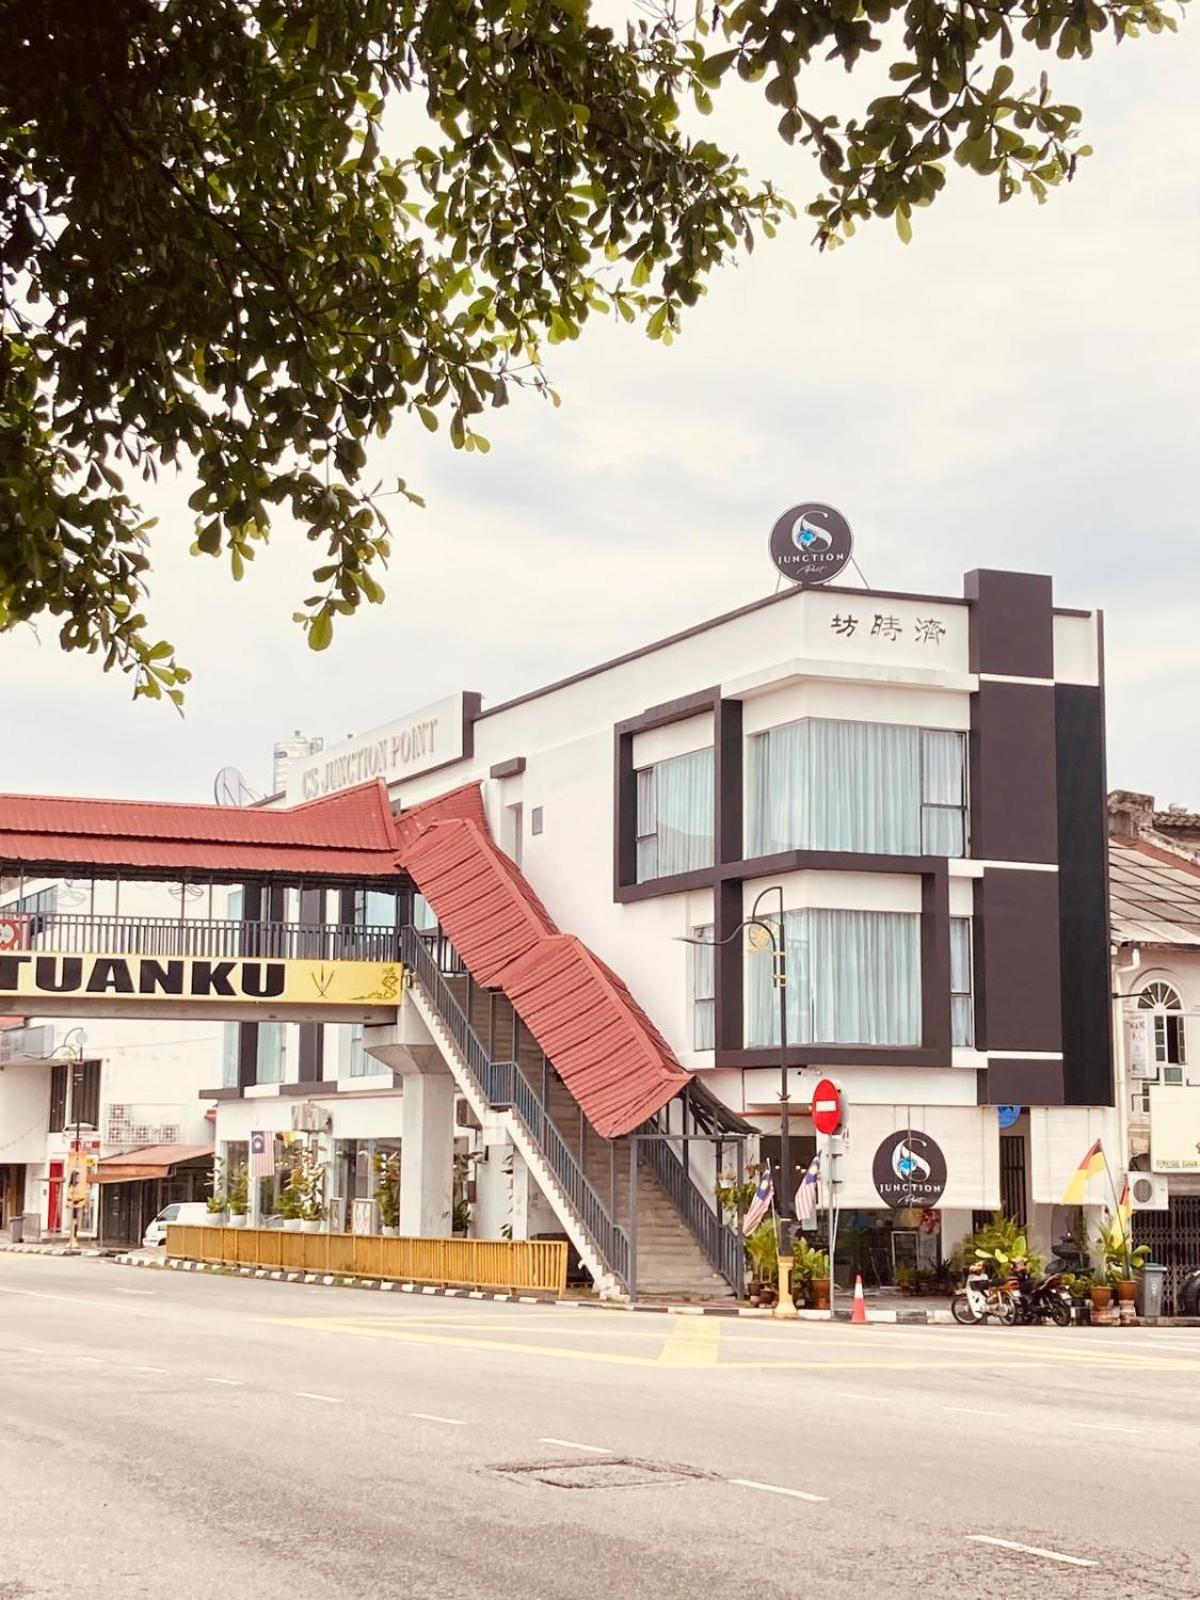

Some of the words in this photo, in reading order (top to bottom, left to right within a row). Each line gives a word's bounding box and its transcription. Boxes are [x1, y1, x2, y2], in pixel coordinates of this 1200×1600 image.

[778, 552, 844, 565] JUNCTION
[303, 767, 319, 799] CS
[321, 738, 387, 793] JUNCTION
[392, 718, 437, 767] POINT
[880, 1183, 941, 1195] JUNCTION
